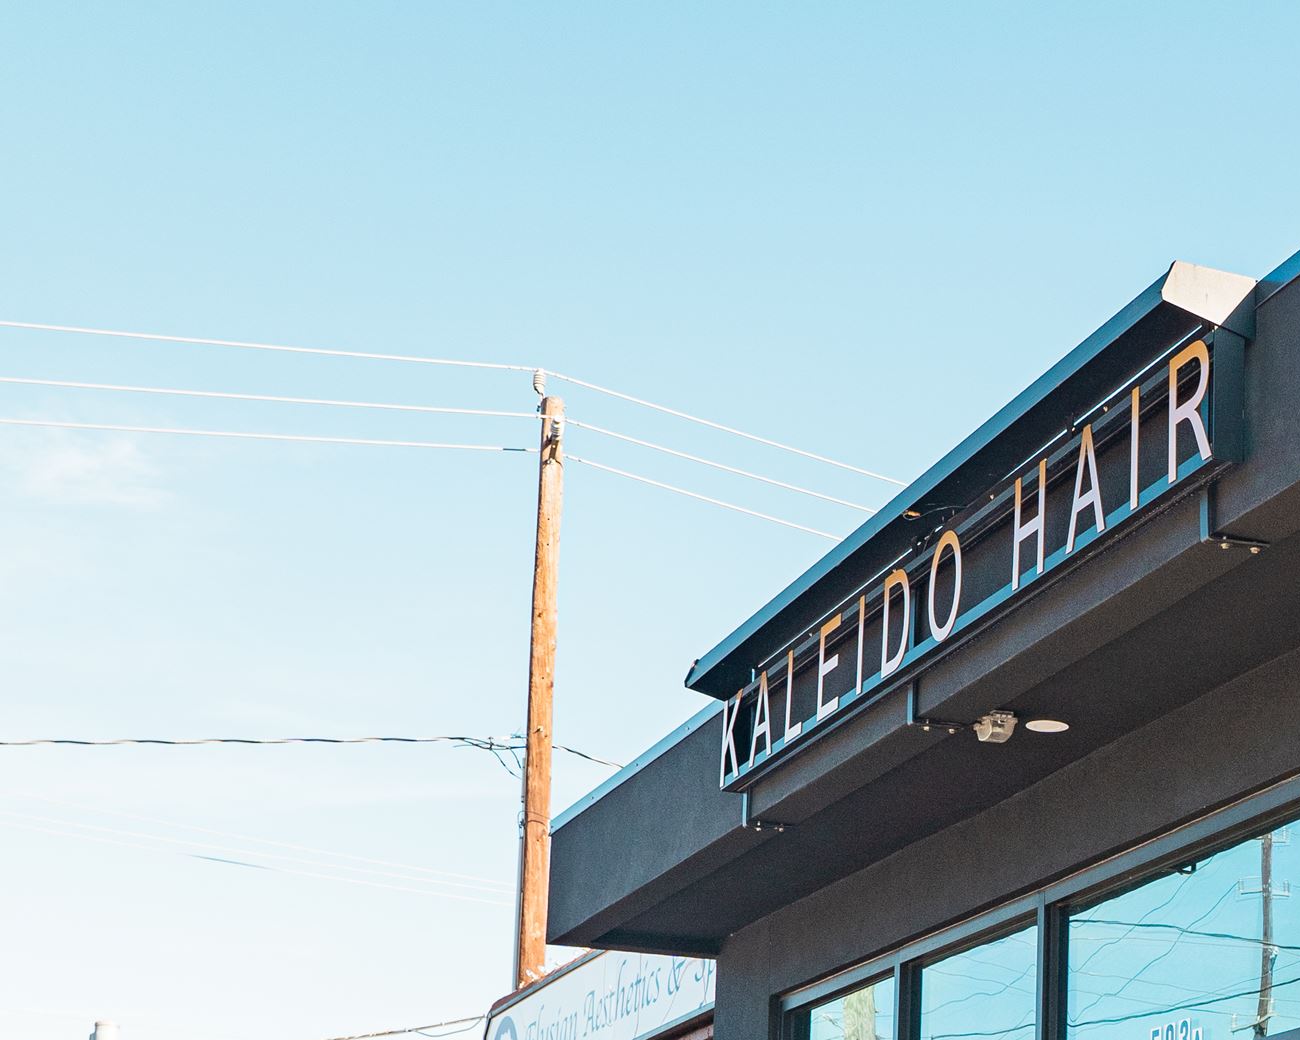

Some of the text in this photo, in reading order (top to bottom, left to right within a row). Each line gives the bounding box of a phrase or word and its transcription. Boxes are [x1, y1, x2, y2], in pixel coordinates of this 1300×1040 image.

[720, 340, 1213, 788] KALEIDO HAIR
[582, 959, 662, 1038] Aesthetics
[667, 955, 689, 996] &
